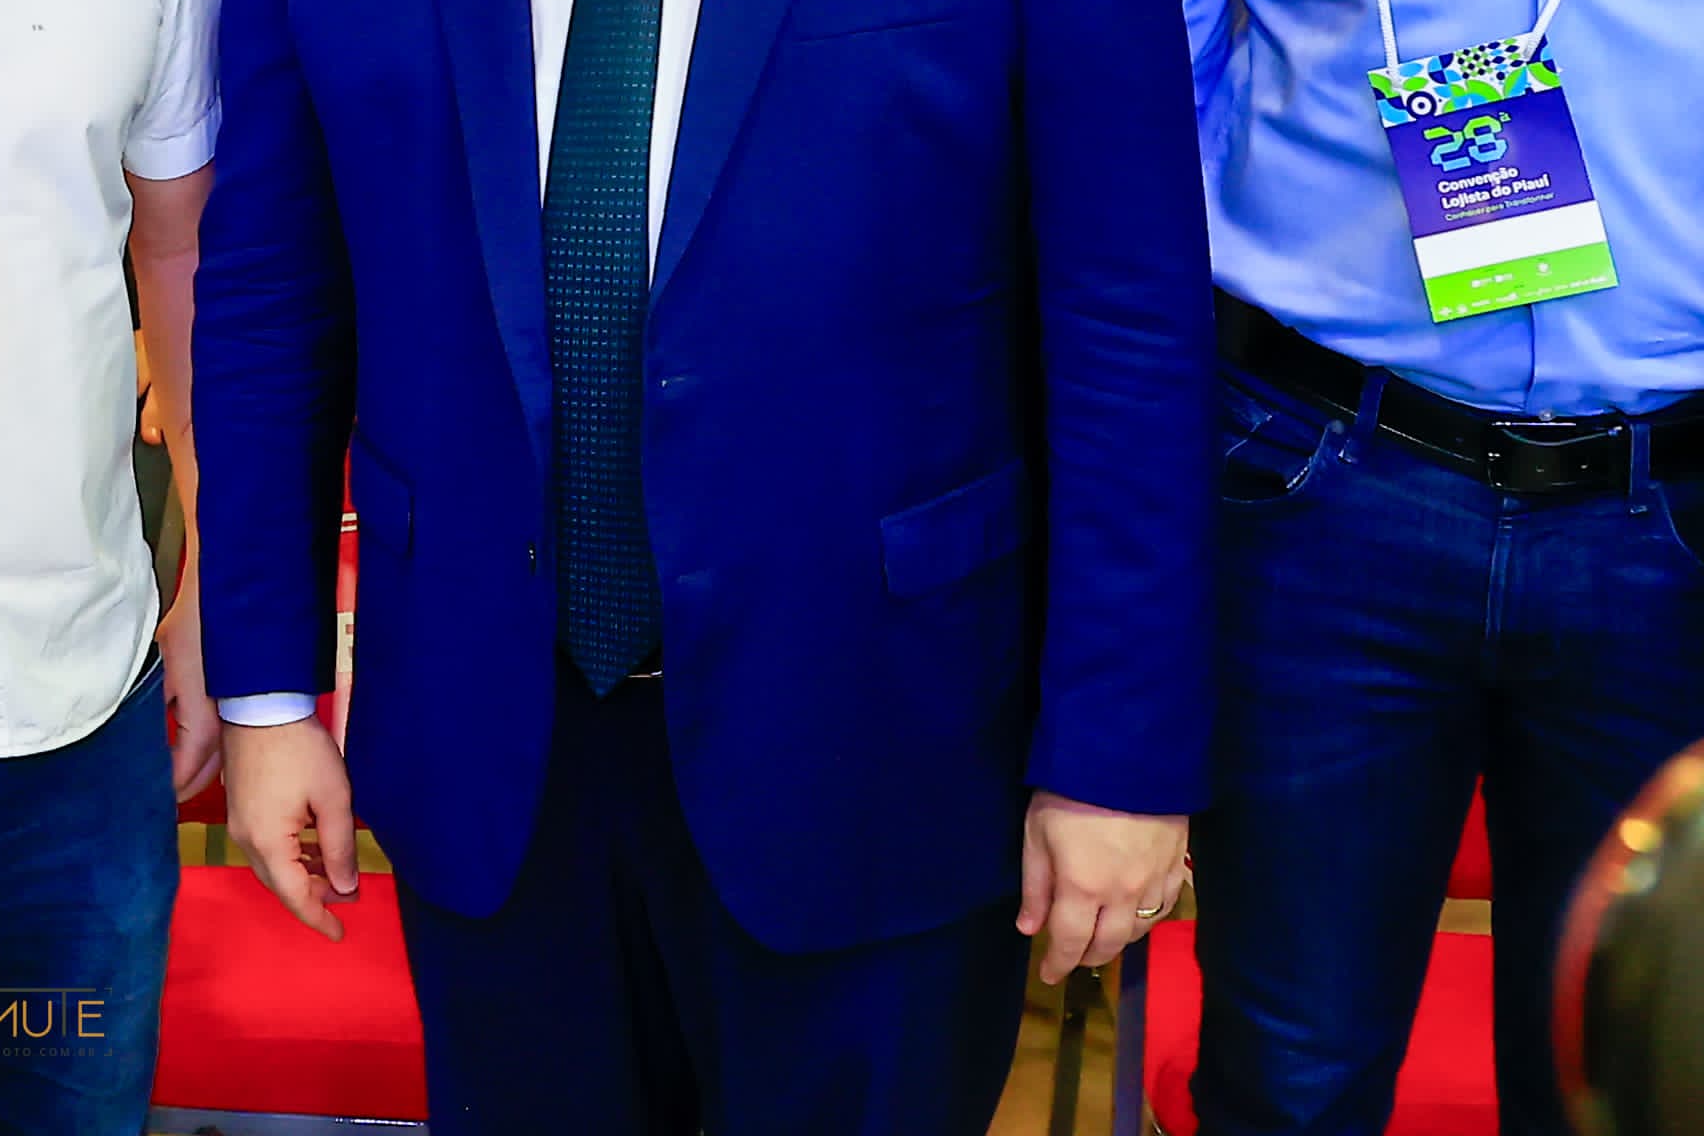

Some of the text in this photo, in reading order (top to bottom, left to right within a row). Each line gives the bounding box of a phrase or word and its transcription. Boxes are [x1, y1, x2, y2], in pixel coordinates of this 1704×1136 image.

[1438, 167, 1518, 193] Convenção
[1441, 174, 1550, 209] Lojista do Piauí
